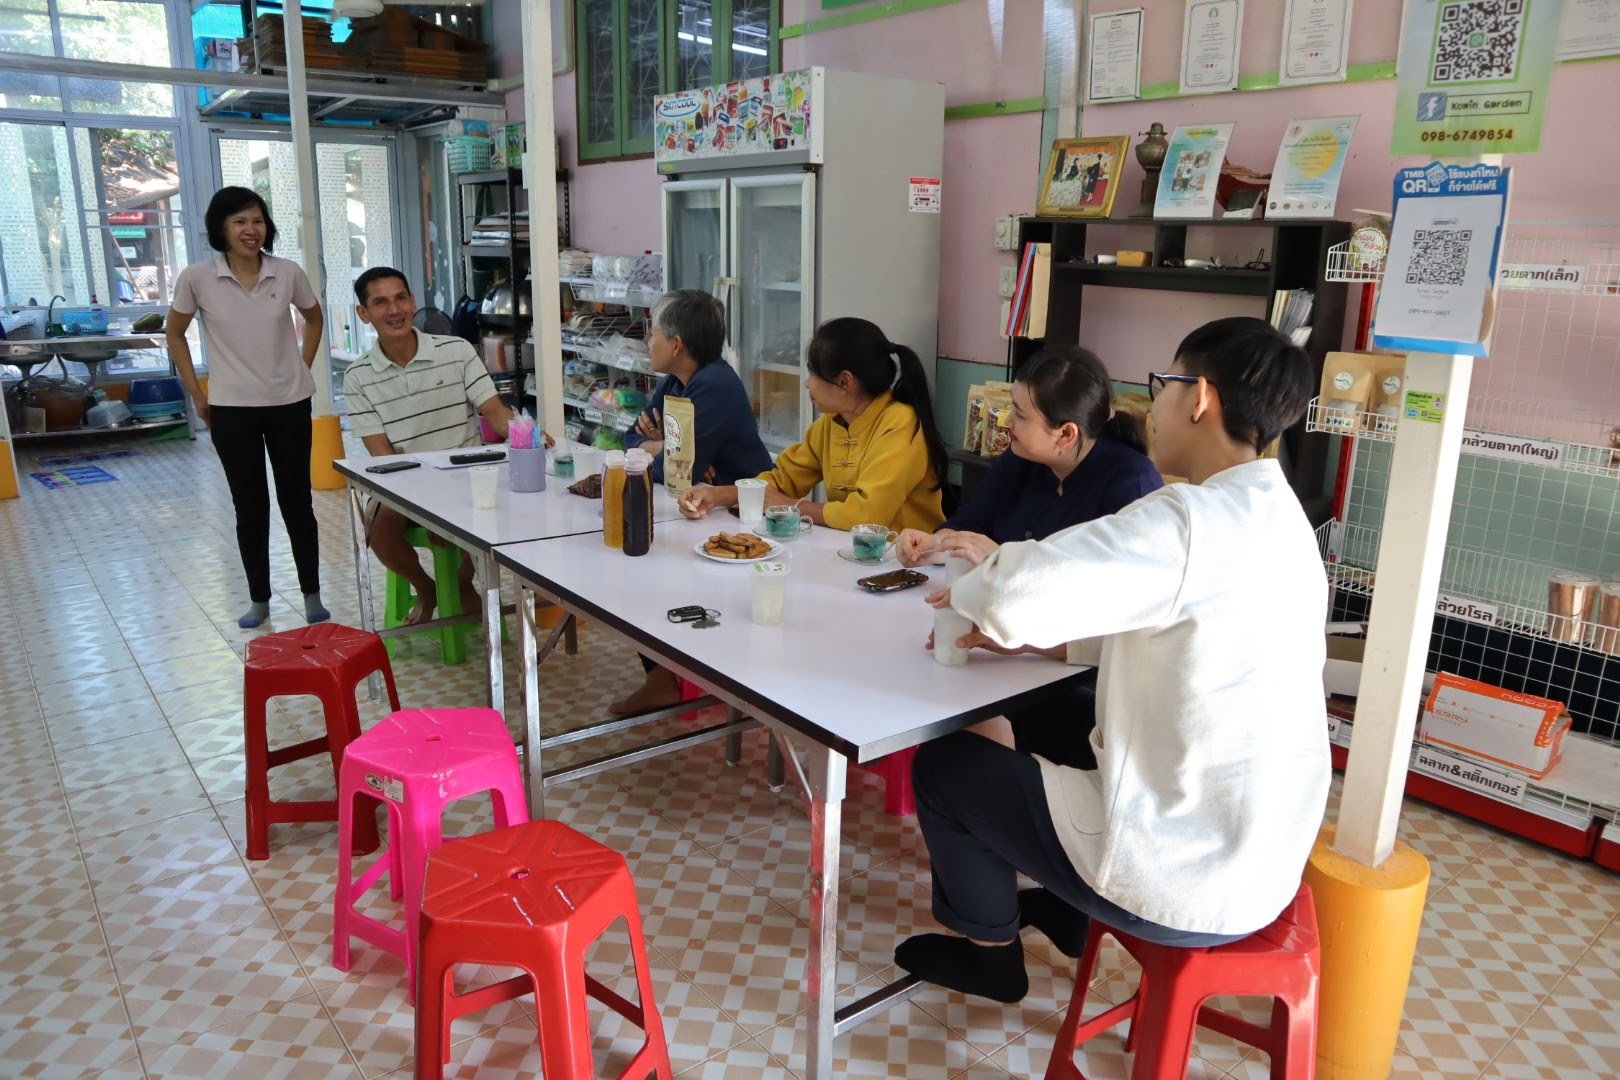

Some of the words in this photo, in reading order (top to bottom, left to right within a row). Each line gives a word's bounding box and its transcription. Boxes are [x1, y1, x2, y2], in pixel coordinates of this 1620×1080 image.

[1483, 98, 1522, 110] Garden
[1420, 128, 1514, 142] 098-6749854
[1403, 170, 1425, 179] TMB
[1402, 179, 1428, 193] QR
[1462, 434, 1559, 461] กล้วยตาก(ใหญ่)
[1437, 596, 1493, 622] ล้วยโรส
[1419, 754, 1521, 797] ฉลาก&สติ๊กเกอร์
